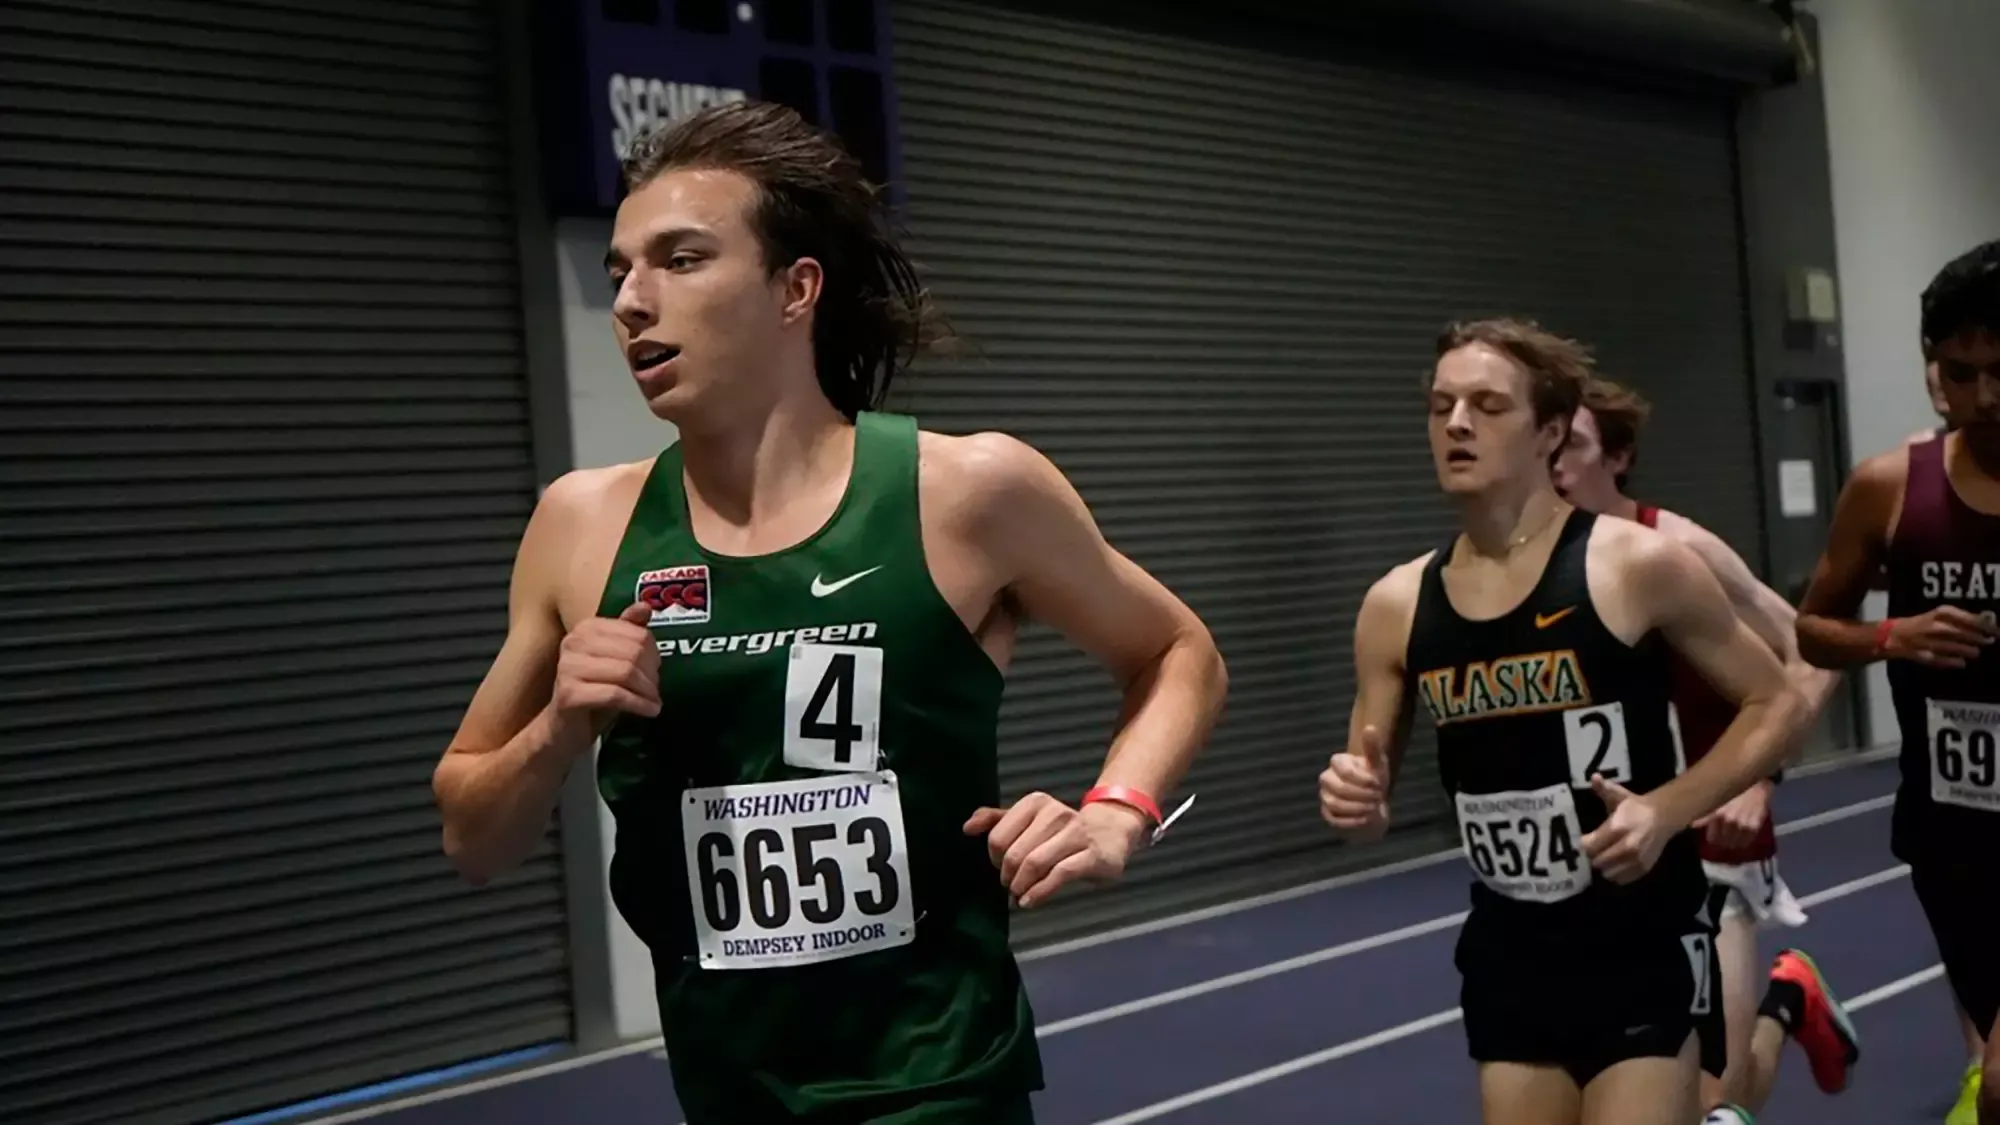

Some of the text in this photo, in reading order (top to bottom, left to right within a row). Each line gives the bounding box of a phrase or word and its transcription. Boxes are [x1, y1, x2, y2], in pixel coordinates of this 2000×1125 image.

[641, 567, 707, 581] CASCADE
[1922, 561, 2000, 599] SEAT
[640, 582, 706, 609] CCC
[656, 621, 878, 656] evergreen
[800, 653, 863, 764] 4
[1579, 711, 1619, 782] 2
[704, 784, 873, 821] WASHINGTON
[1465, 813, 1580, 878] 6524
[697, 817, 899, 932] 6653
[723, 935, 806, 957] DEMPSEY
[812, 922, 886, 950] INDOOR
